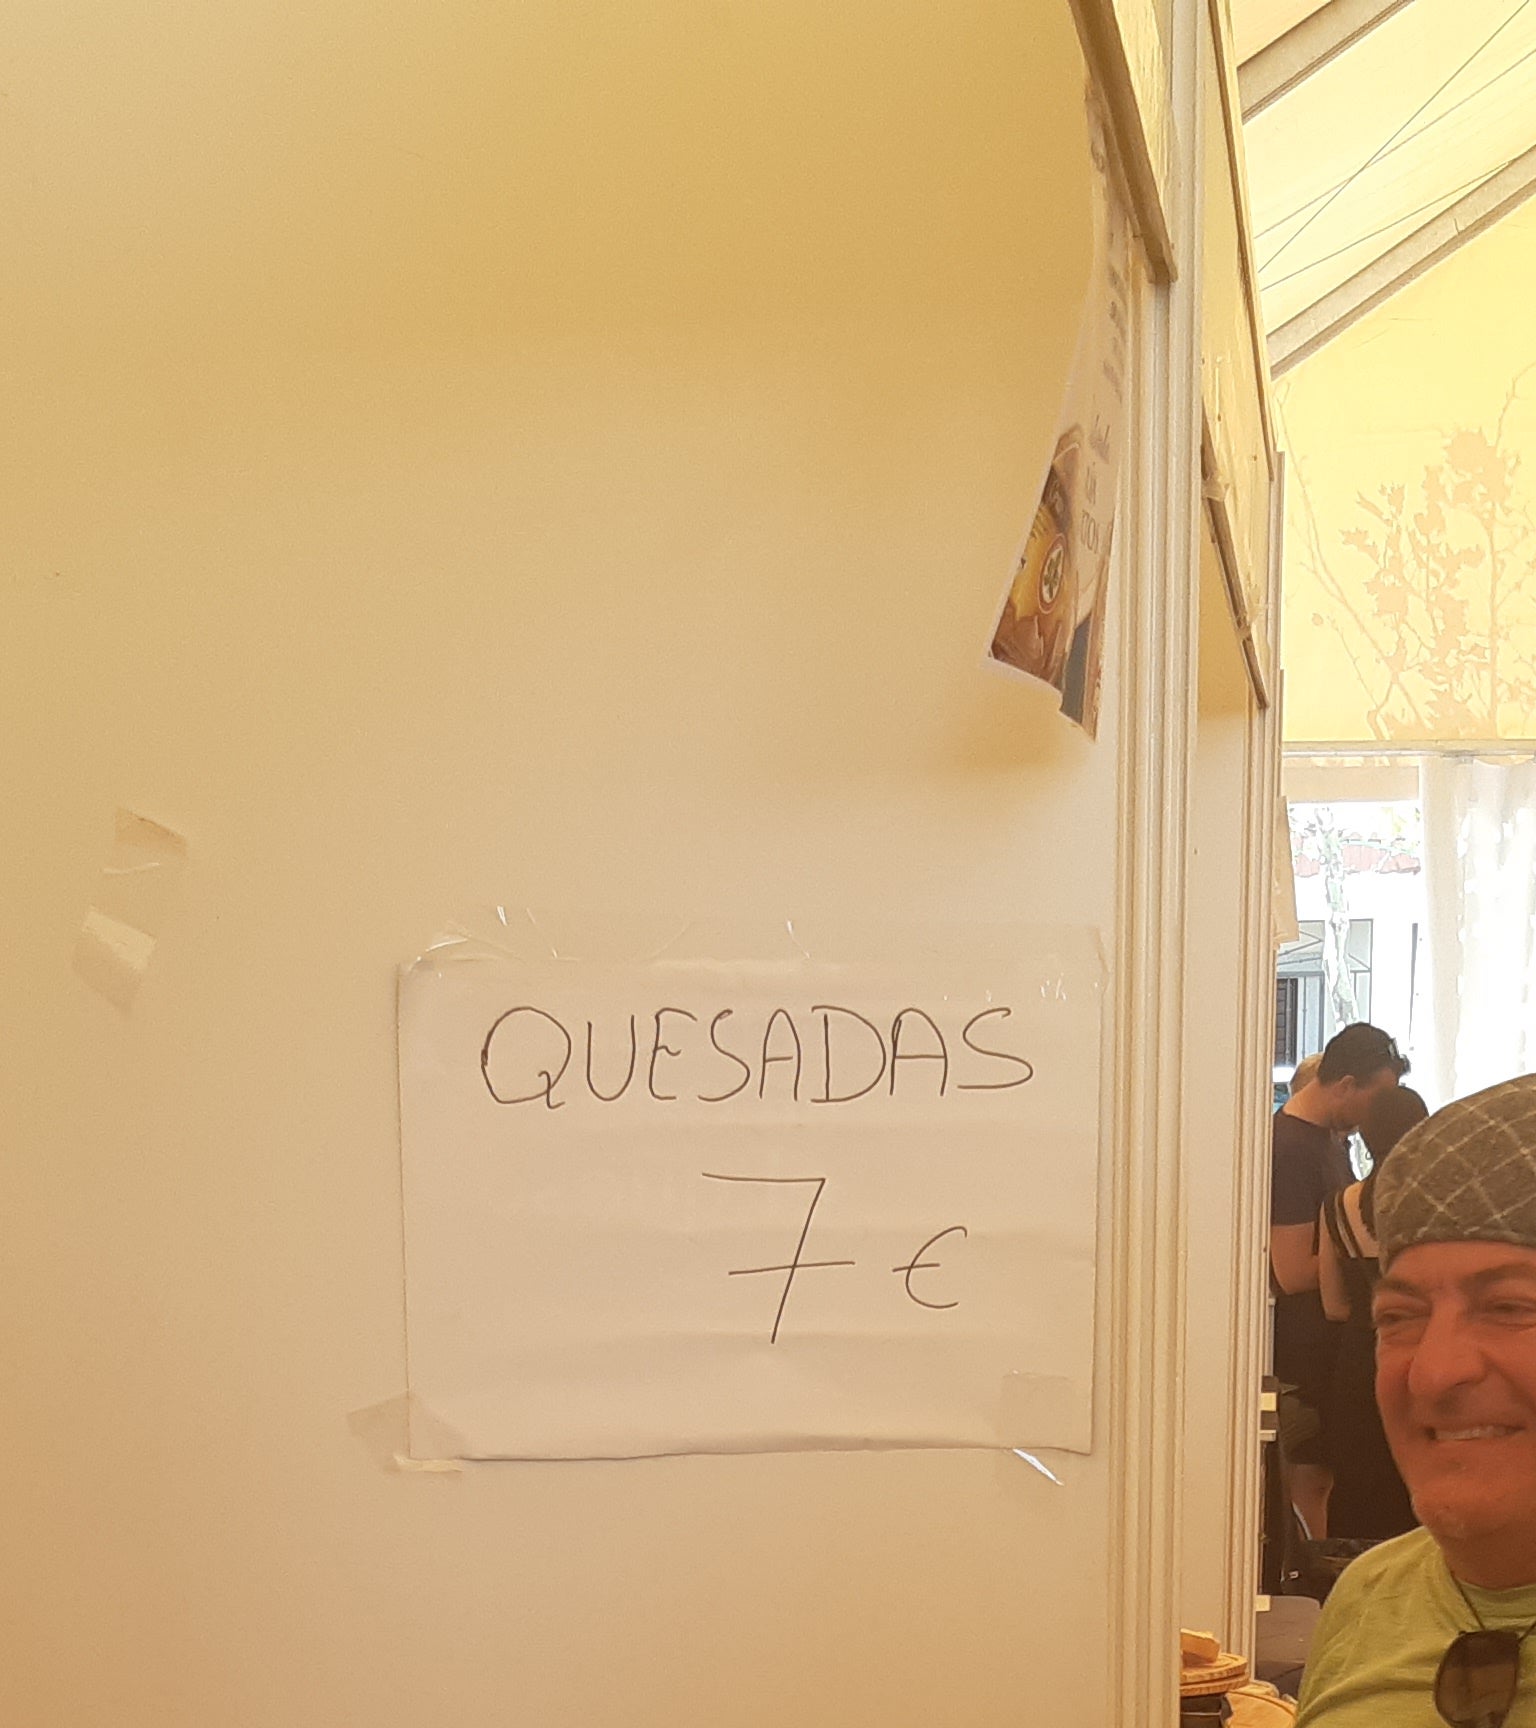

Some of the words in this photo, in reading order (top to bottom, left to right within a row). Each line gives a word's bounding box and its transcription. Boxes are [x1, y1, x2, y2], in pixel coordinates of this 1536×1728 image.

[480, 1005, 1034, 1110] QUESADAS
[701, 1172, 856, 1345] 7
[891, 1225, 968, 1309] €
